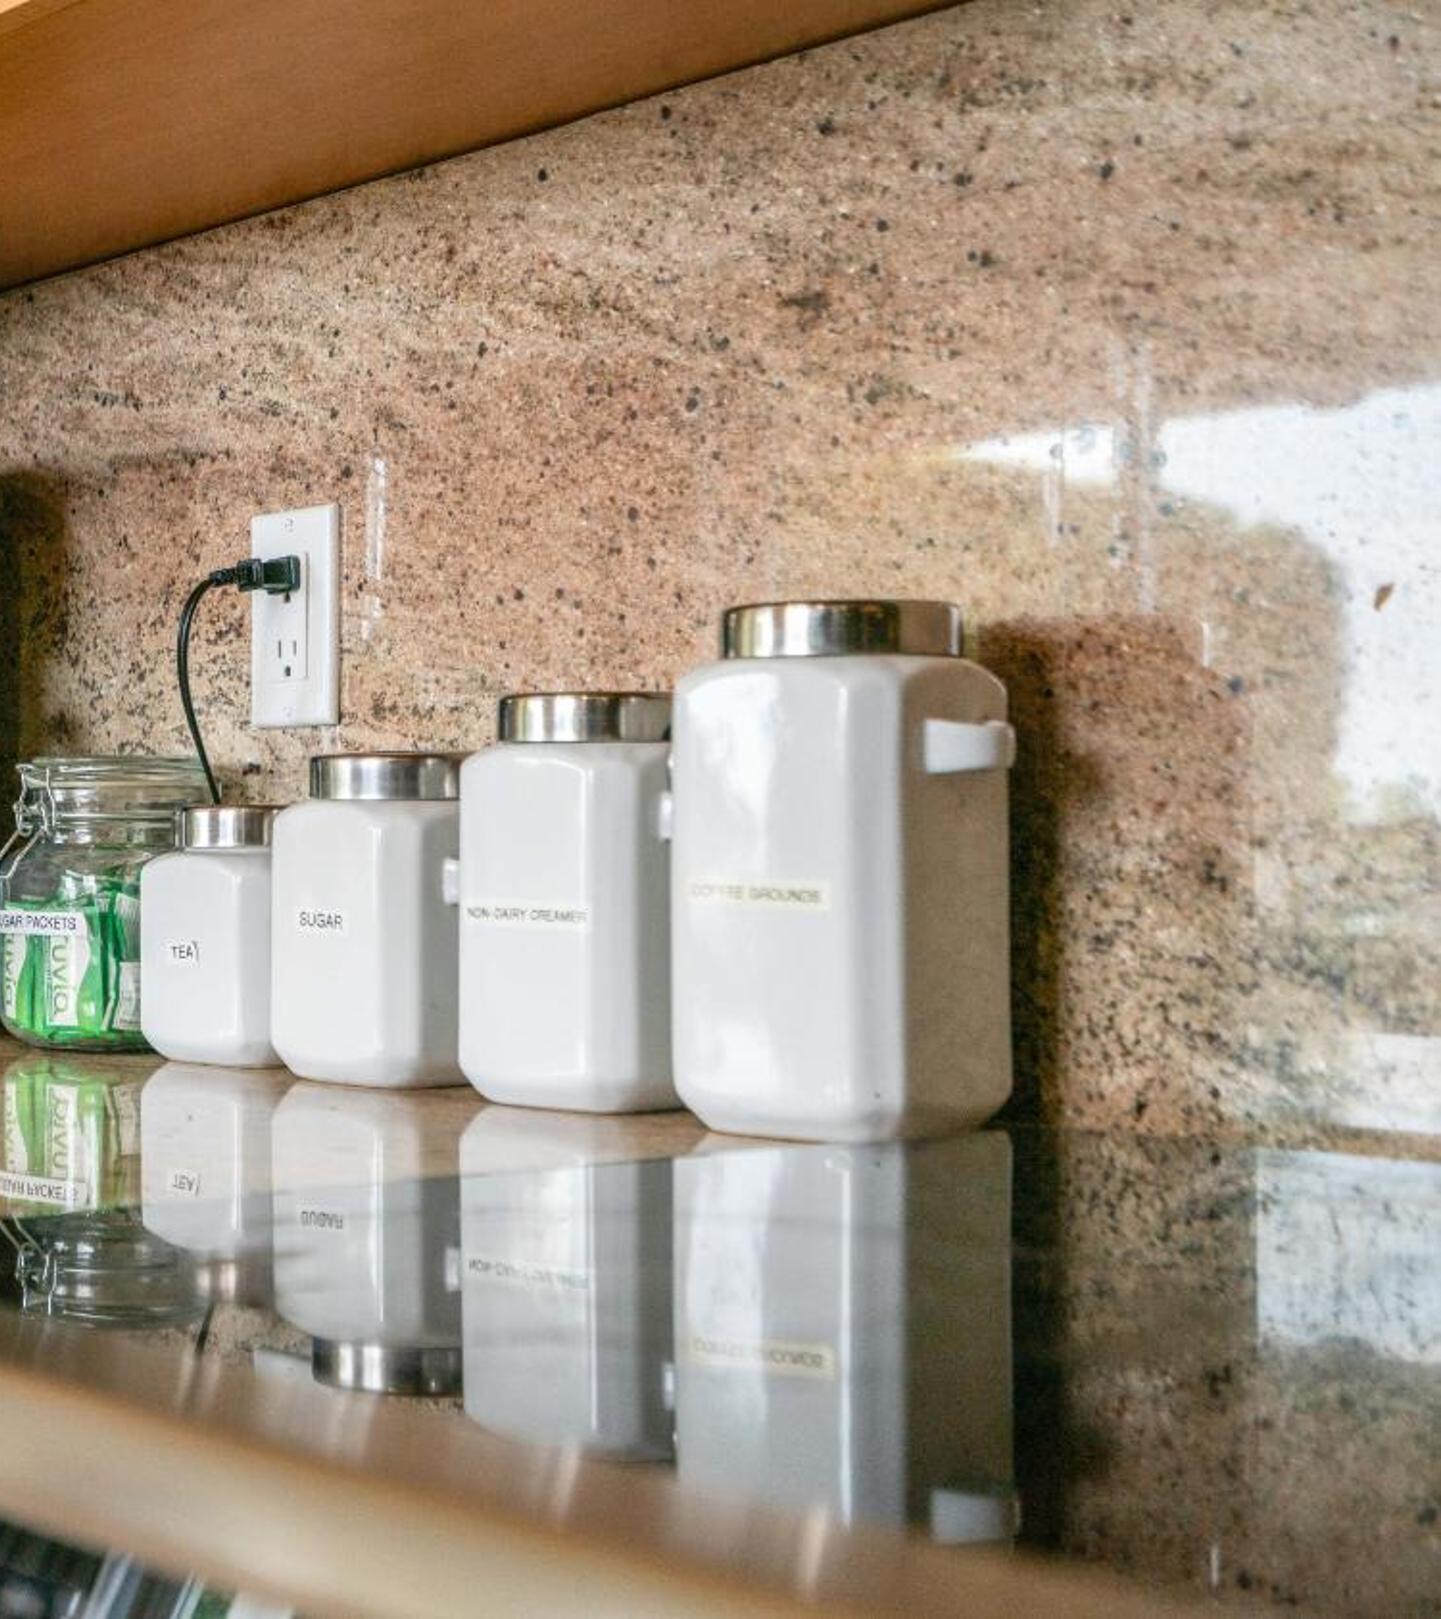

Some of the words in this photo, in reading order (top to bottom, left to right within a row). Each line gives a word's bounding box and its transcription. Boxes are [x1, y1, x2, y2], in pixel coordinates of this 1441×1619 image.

[26, 915, 77, 931] PACKETS
[298, 911, 344, 930] SUGAR
[171, 945, 194, 960] TEA
